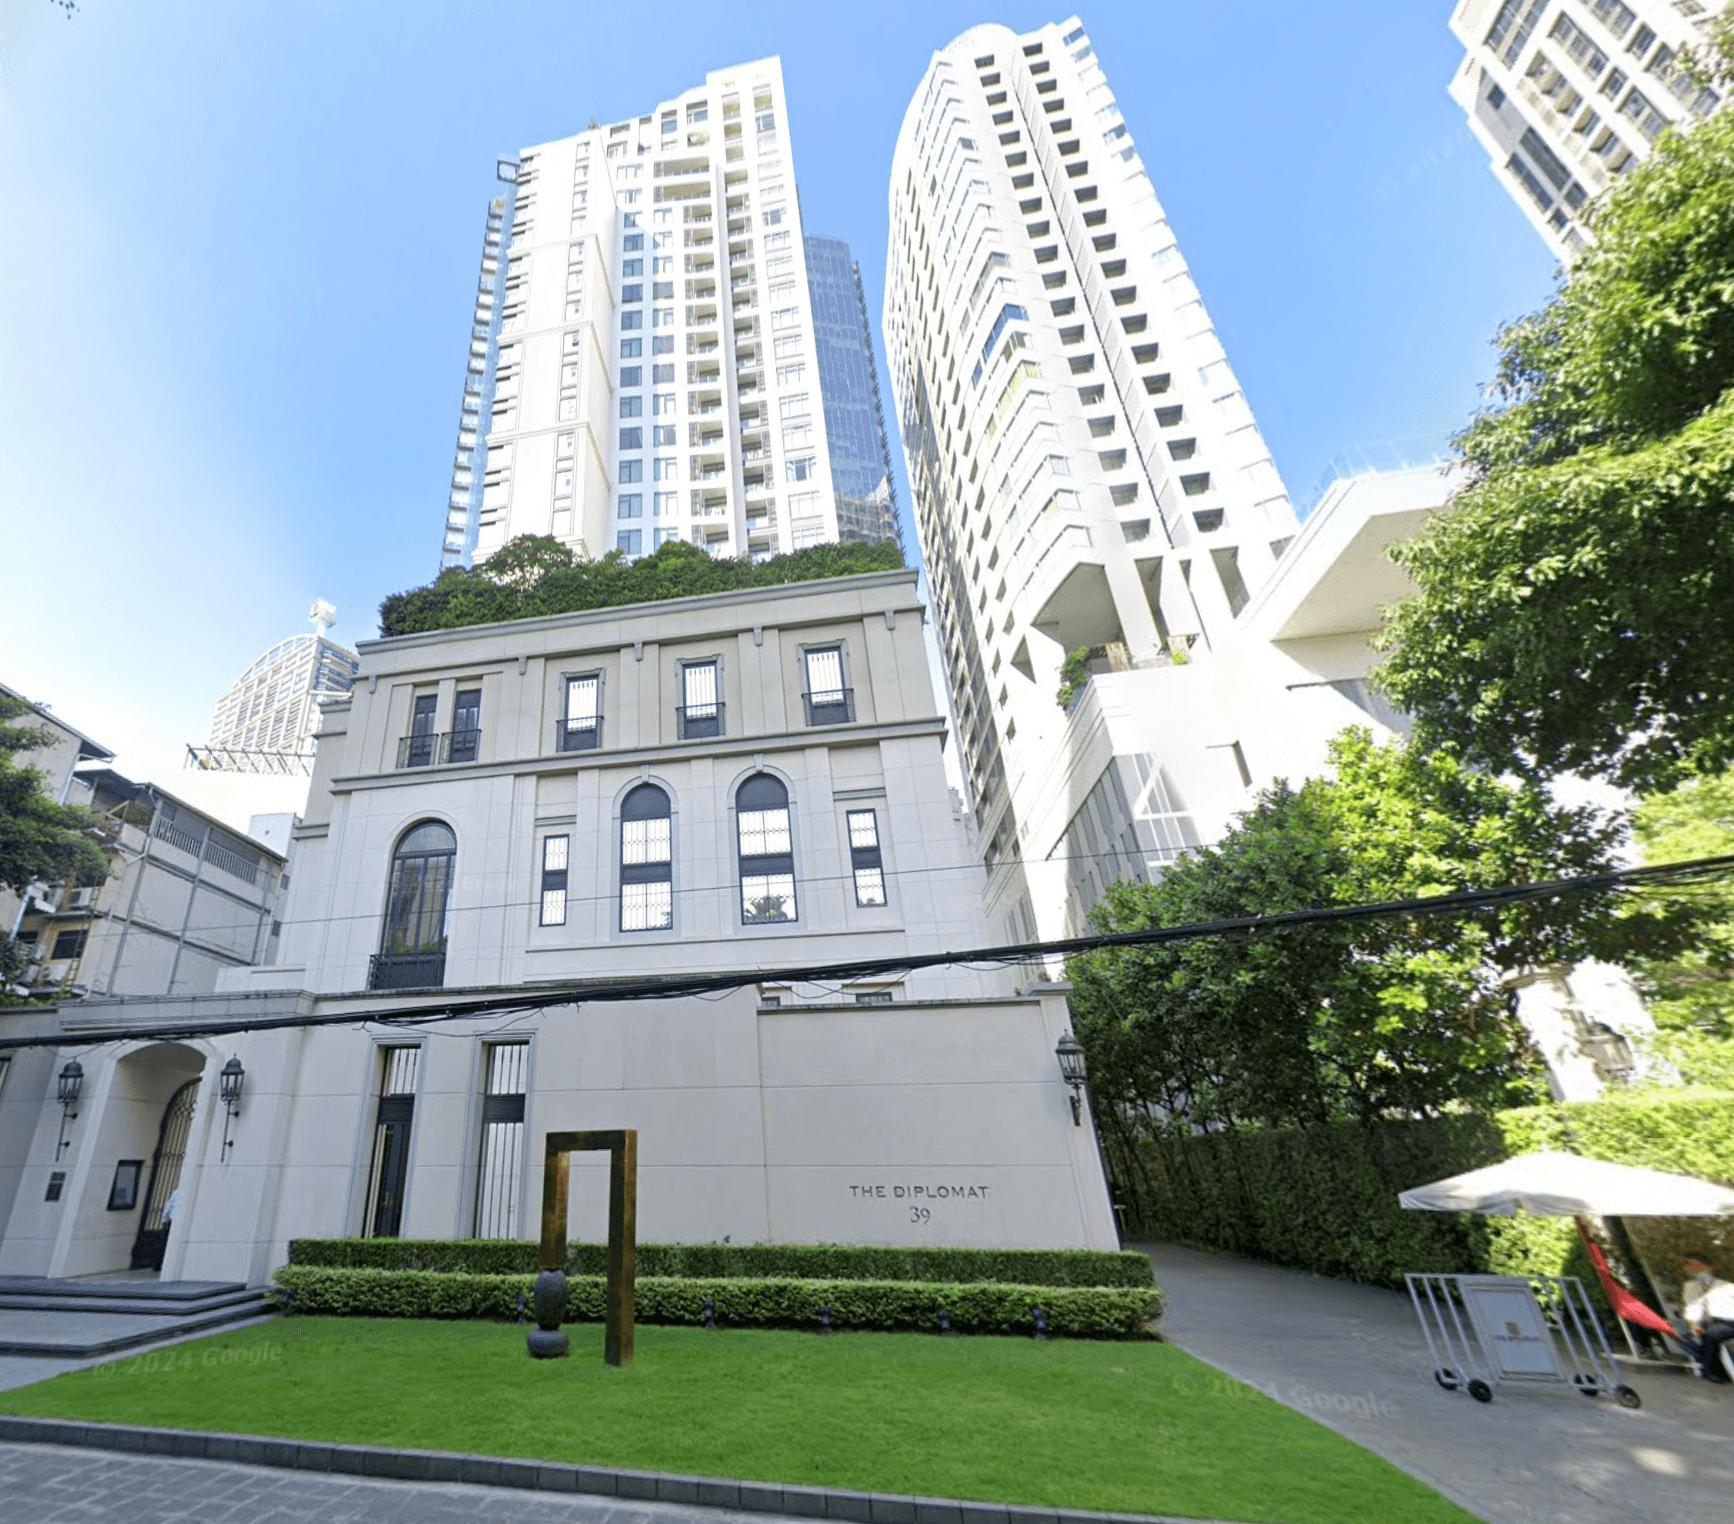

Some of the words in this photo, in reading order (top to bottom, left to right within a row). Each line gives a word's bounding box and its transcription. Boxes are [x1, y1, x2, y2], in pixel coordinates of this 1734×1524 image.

[849, 1185, 887, 1199] THE
[893, 1185, 988, 1199] DIPLOMAT
[909, 1205, 931, 1225] 39
